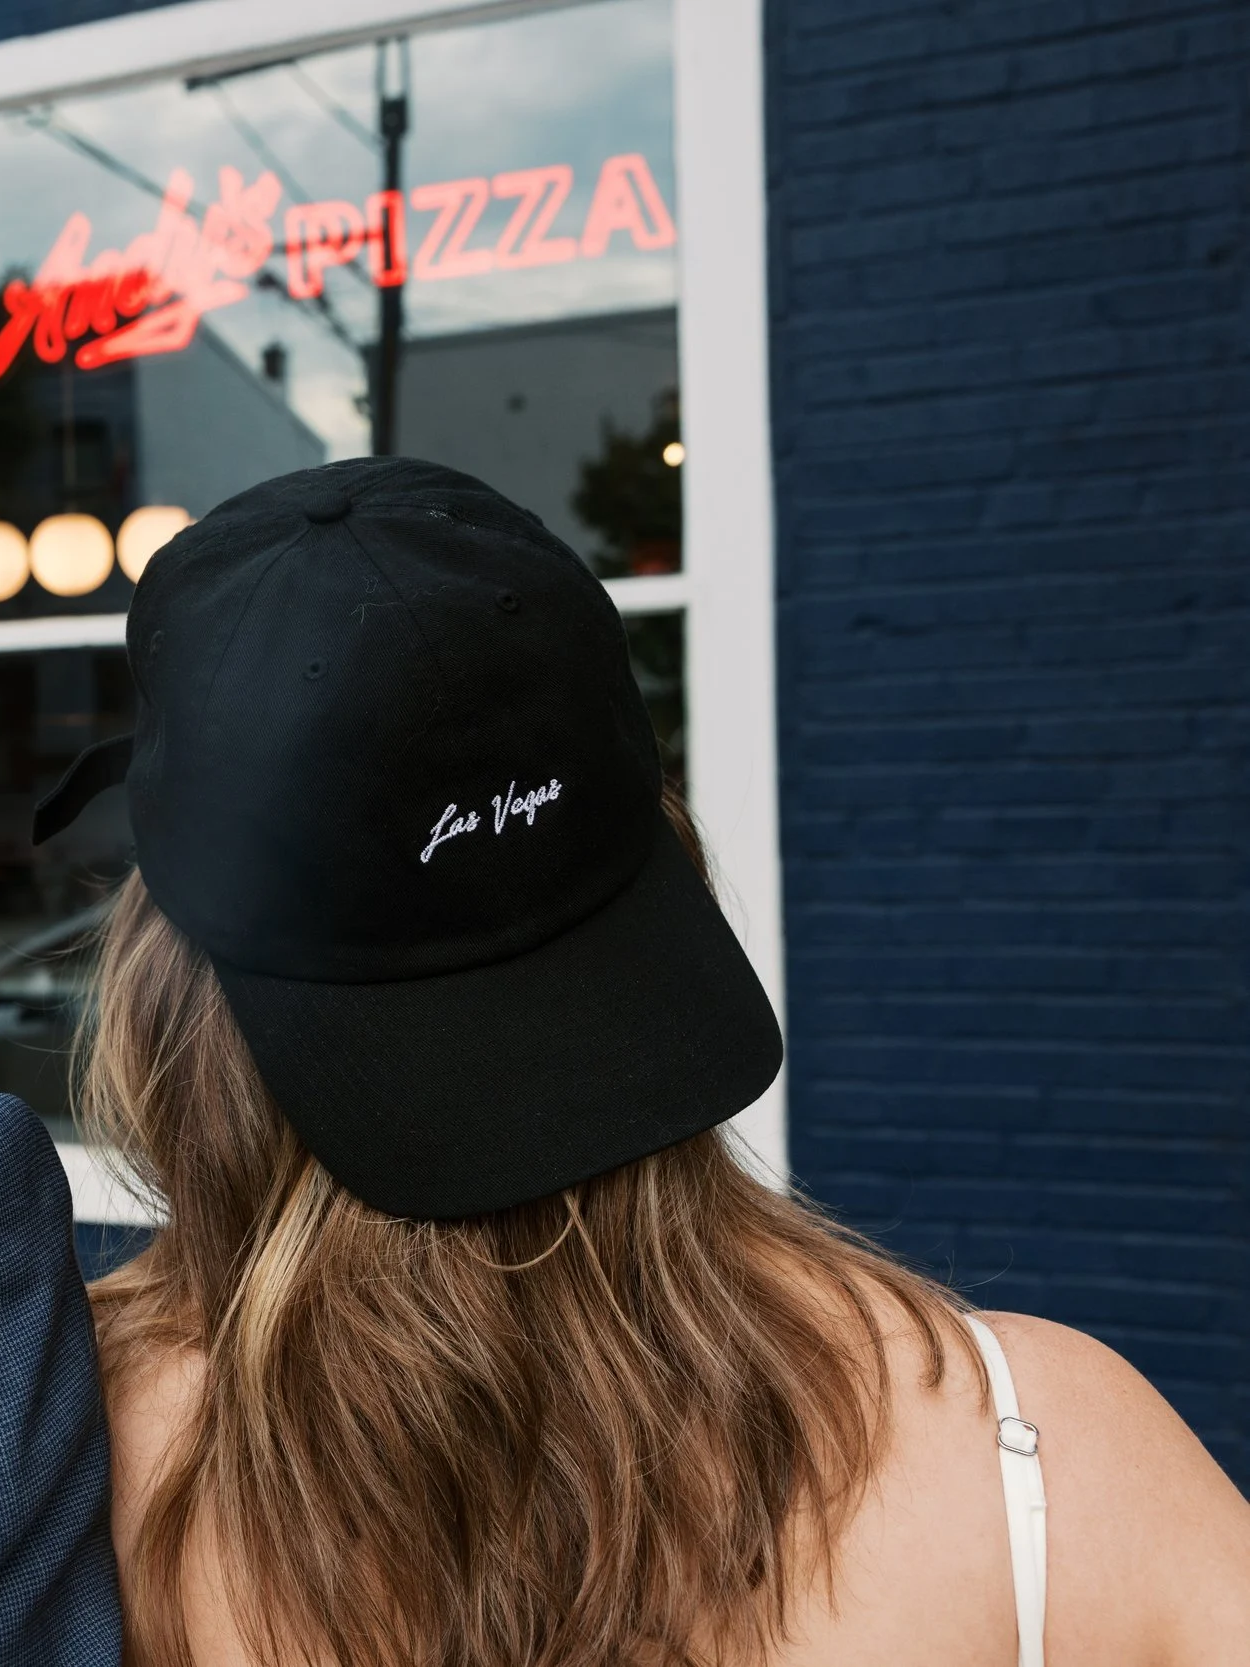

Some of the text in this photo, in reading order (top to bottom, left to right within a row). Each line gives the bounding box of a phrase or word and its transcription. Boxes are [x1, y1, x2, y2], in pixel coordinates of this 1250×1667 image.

[285, 153, 678, 300] PIZZA
[420, 778, 562, 863] Las Vegas
